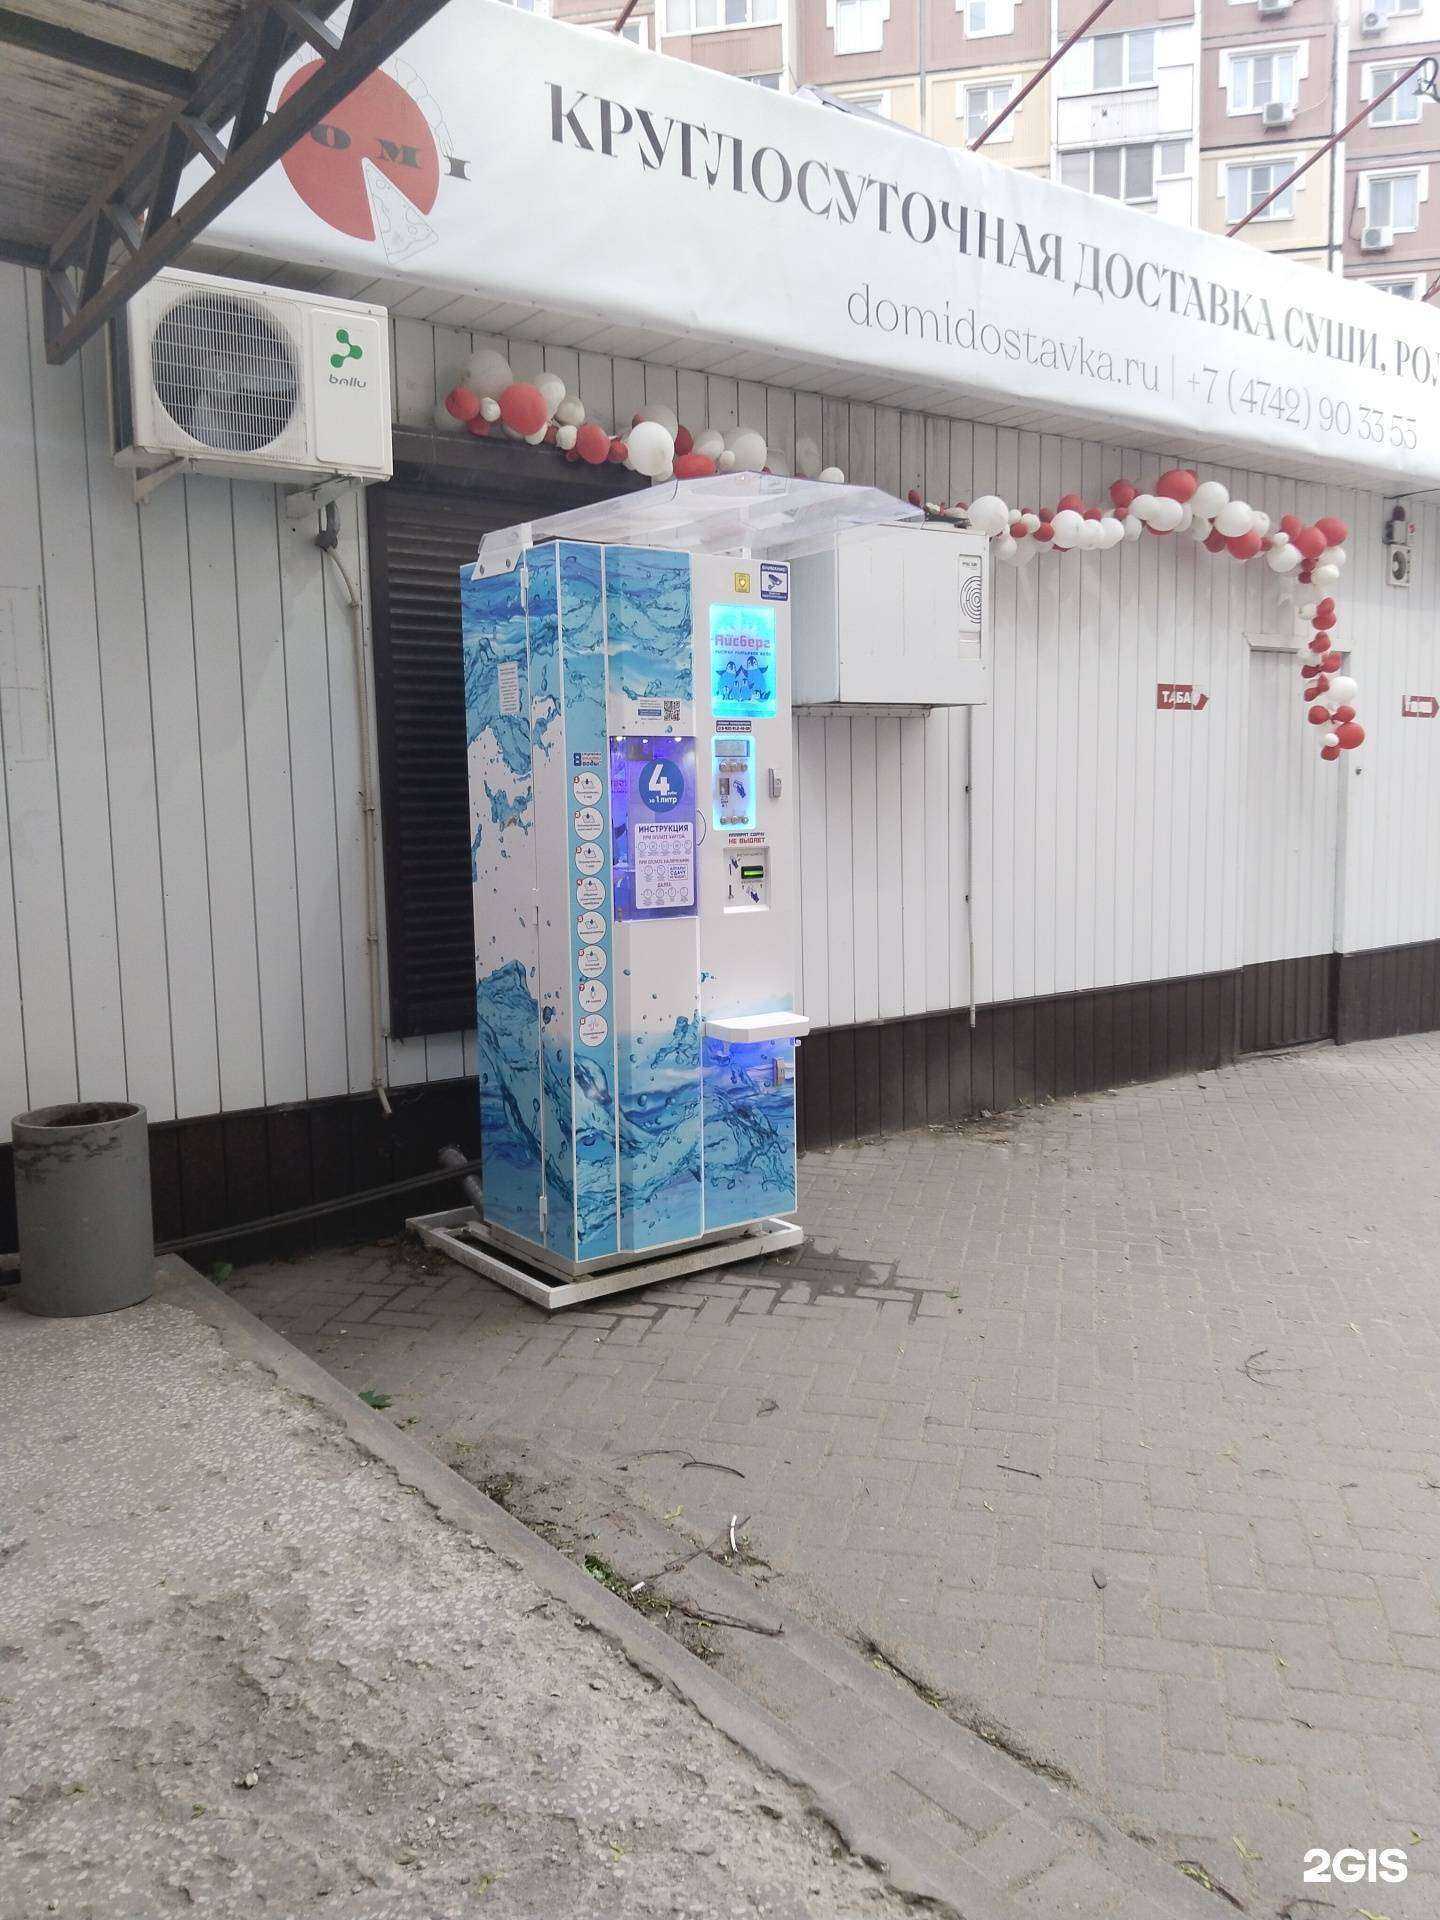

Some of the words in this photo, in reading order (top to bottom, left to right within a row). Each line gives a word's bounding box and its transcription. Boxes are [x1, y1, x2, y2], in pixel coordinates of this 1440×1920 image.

[545, 81, 1065, 283] КРУГЛОСУТОЧНАЯ
[1072, 242, 1276, 341] ДОСТАВКА
[1283, 306, 1388, 373] СУШИ,
[847, 282, 1161, 393] domidostavka.ru
[1186, 368, 1219, 404] +7
[1228, 368, 1312, 431] (4742)
[1318, 396, 1353, 436] 90
[1357, 406, 1387, 443] 33
[1389, 415, 1418, 450] 55
[328, 373, 367, 389] ballu
[714, 634, 771, 651] Айсберг
[648, 763, 669, 796] 4
[638, 824, 689, 834] ИНСТРУКЦИЯ
